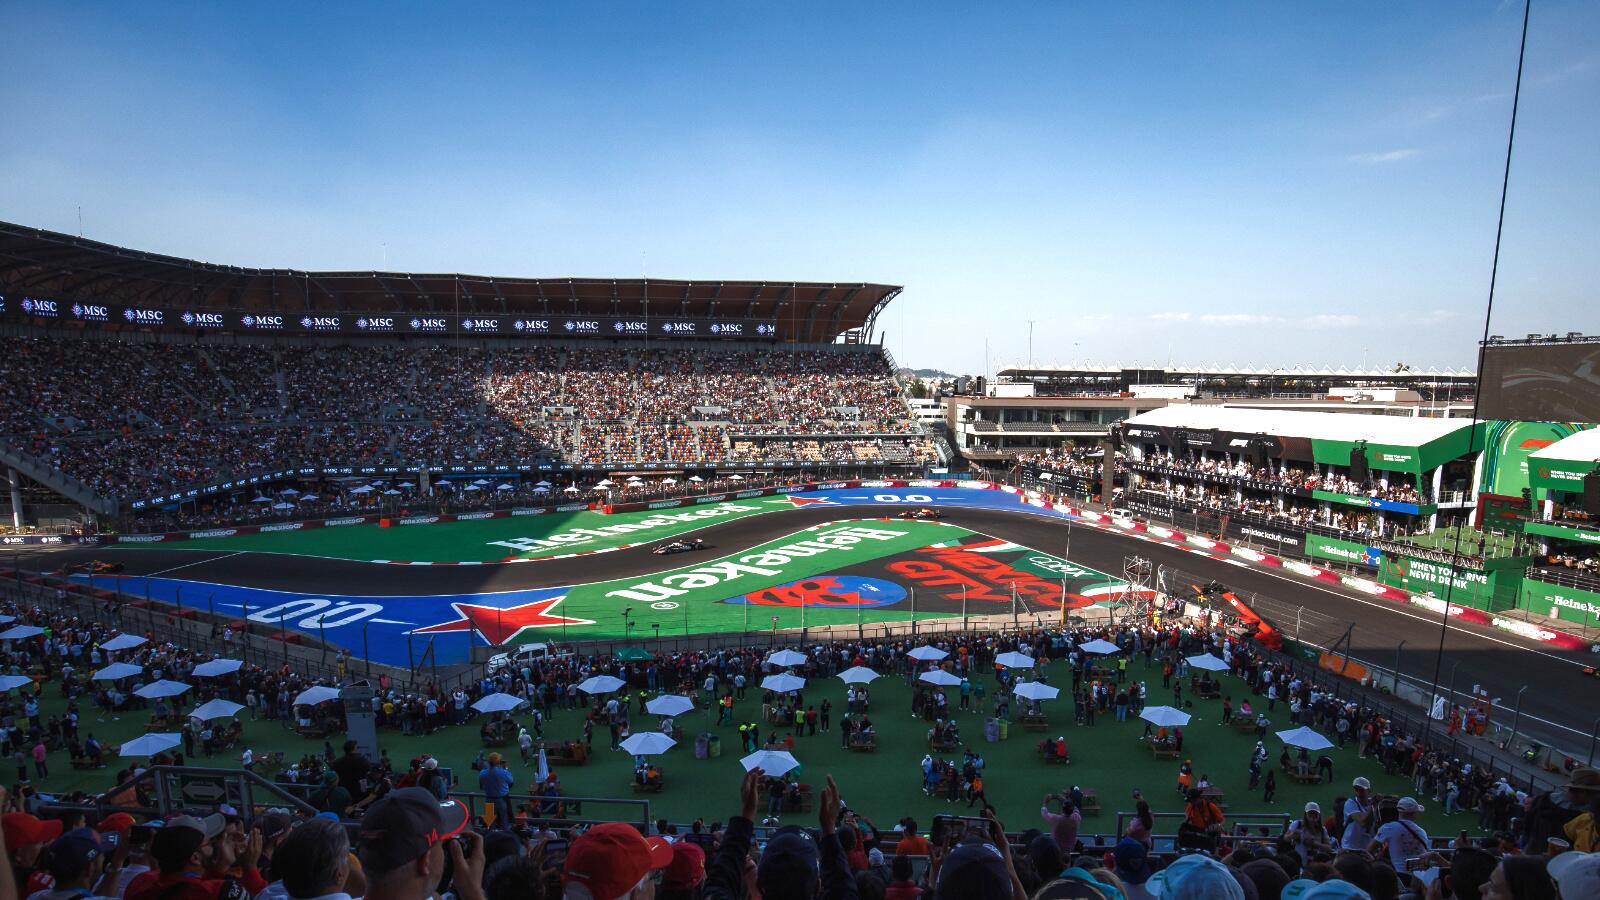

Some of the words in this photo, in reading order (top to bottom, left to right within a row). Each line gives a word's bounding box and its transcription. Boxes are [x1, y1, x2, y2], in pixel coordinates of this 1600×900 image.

[34, 299, 57, 312] MSC
[84, 305, 108, 317] MSC
[136, 309, 163, 321] MSC
[196, 313, 223, 323] MSC
[256, 316, 283, 325] MSC
[314, 318, 340, 326] MSC
[369, 318, 393, 327] MSC
[422, 319, 446, 327] MSC
[474, 319, 498, 328] MSC
[525, 320, 549, 329] MSC
[576, 321, 599, 330] MSC
[625, 322, 648, 331] MSC
[673, 323, 696, 331] MSC
[720, 324, 742, 332] MSC
[1159, 467, 1208, 481] ADRENALINE
[1213, 476, 1241, 486] MEETS
[1246, 480, 1298, 495] ELEGANCE
[486, 502, 763, 552] Heineken
[605, 526, 911, 602] Heineken
[1410, 560, 1436, 573] WHEN
[1437, 566, 1456, 578] YOU
[1409, 569, 1437, 583] NEVER
[1438, 576, 1468, 590] DRNK
